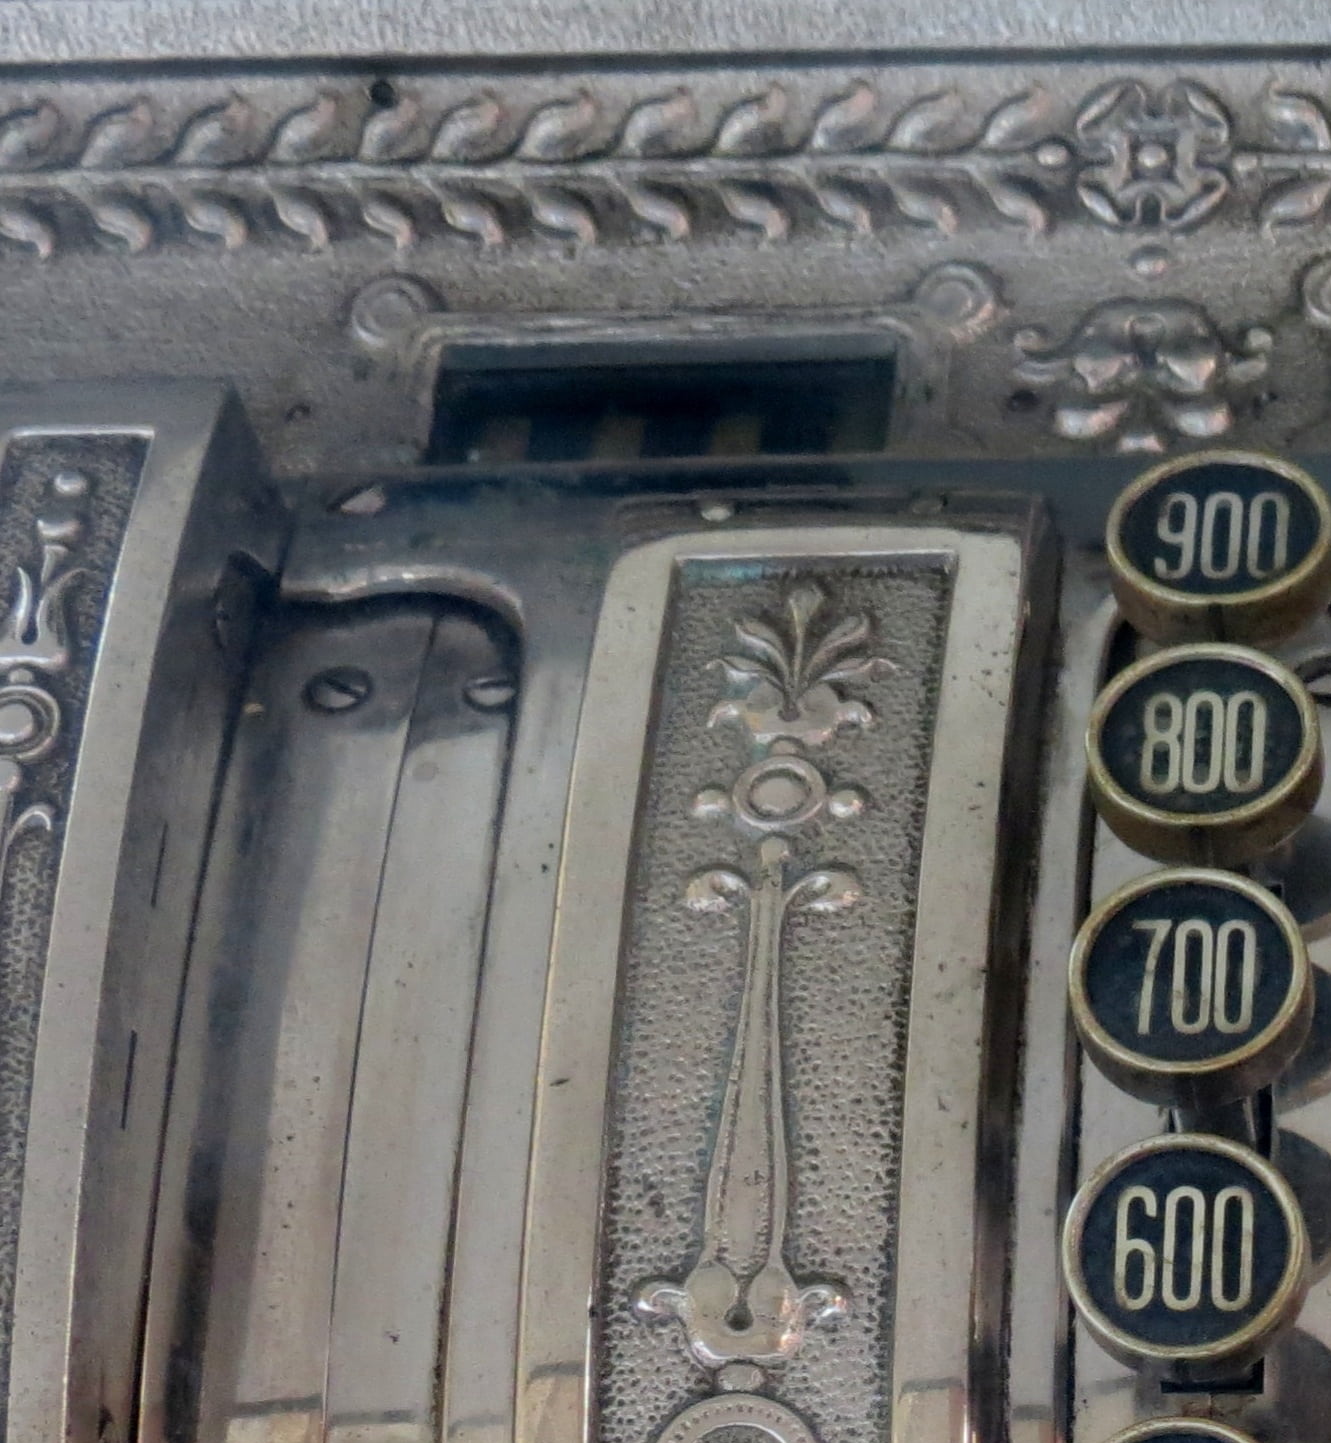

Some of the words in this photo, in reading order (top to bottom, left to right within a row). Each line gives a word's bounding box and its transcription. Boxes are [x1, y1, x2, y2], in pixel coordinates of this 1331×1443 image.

[1155, 492, 1289, 578] 900
[1141, 690, 1267, 793] 800
[1137, 919, 1256, 1034] 700
[1114, 1186, 1253, 1310] 600
